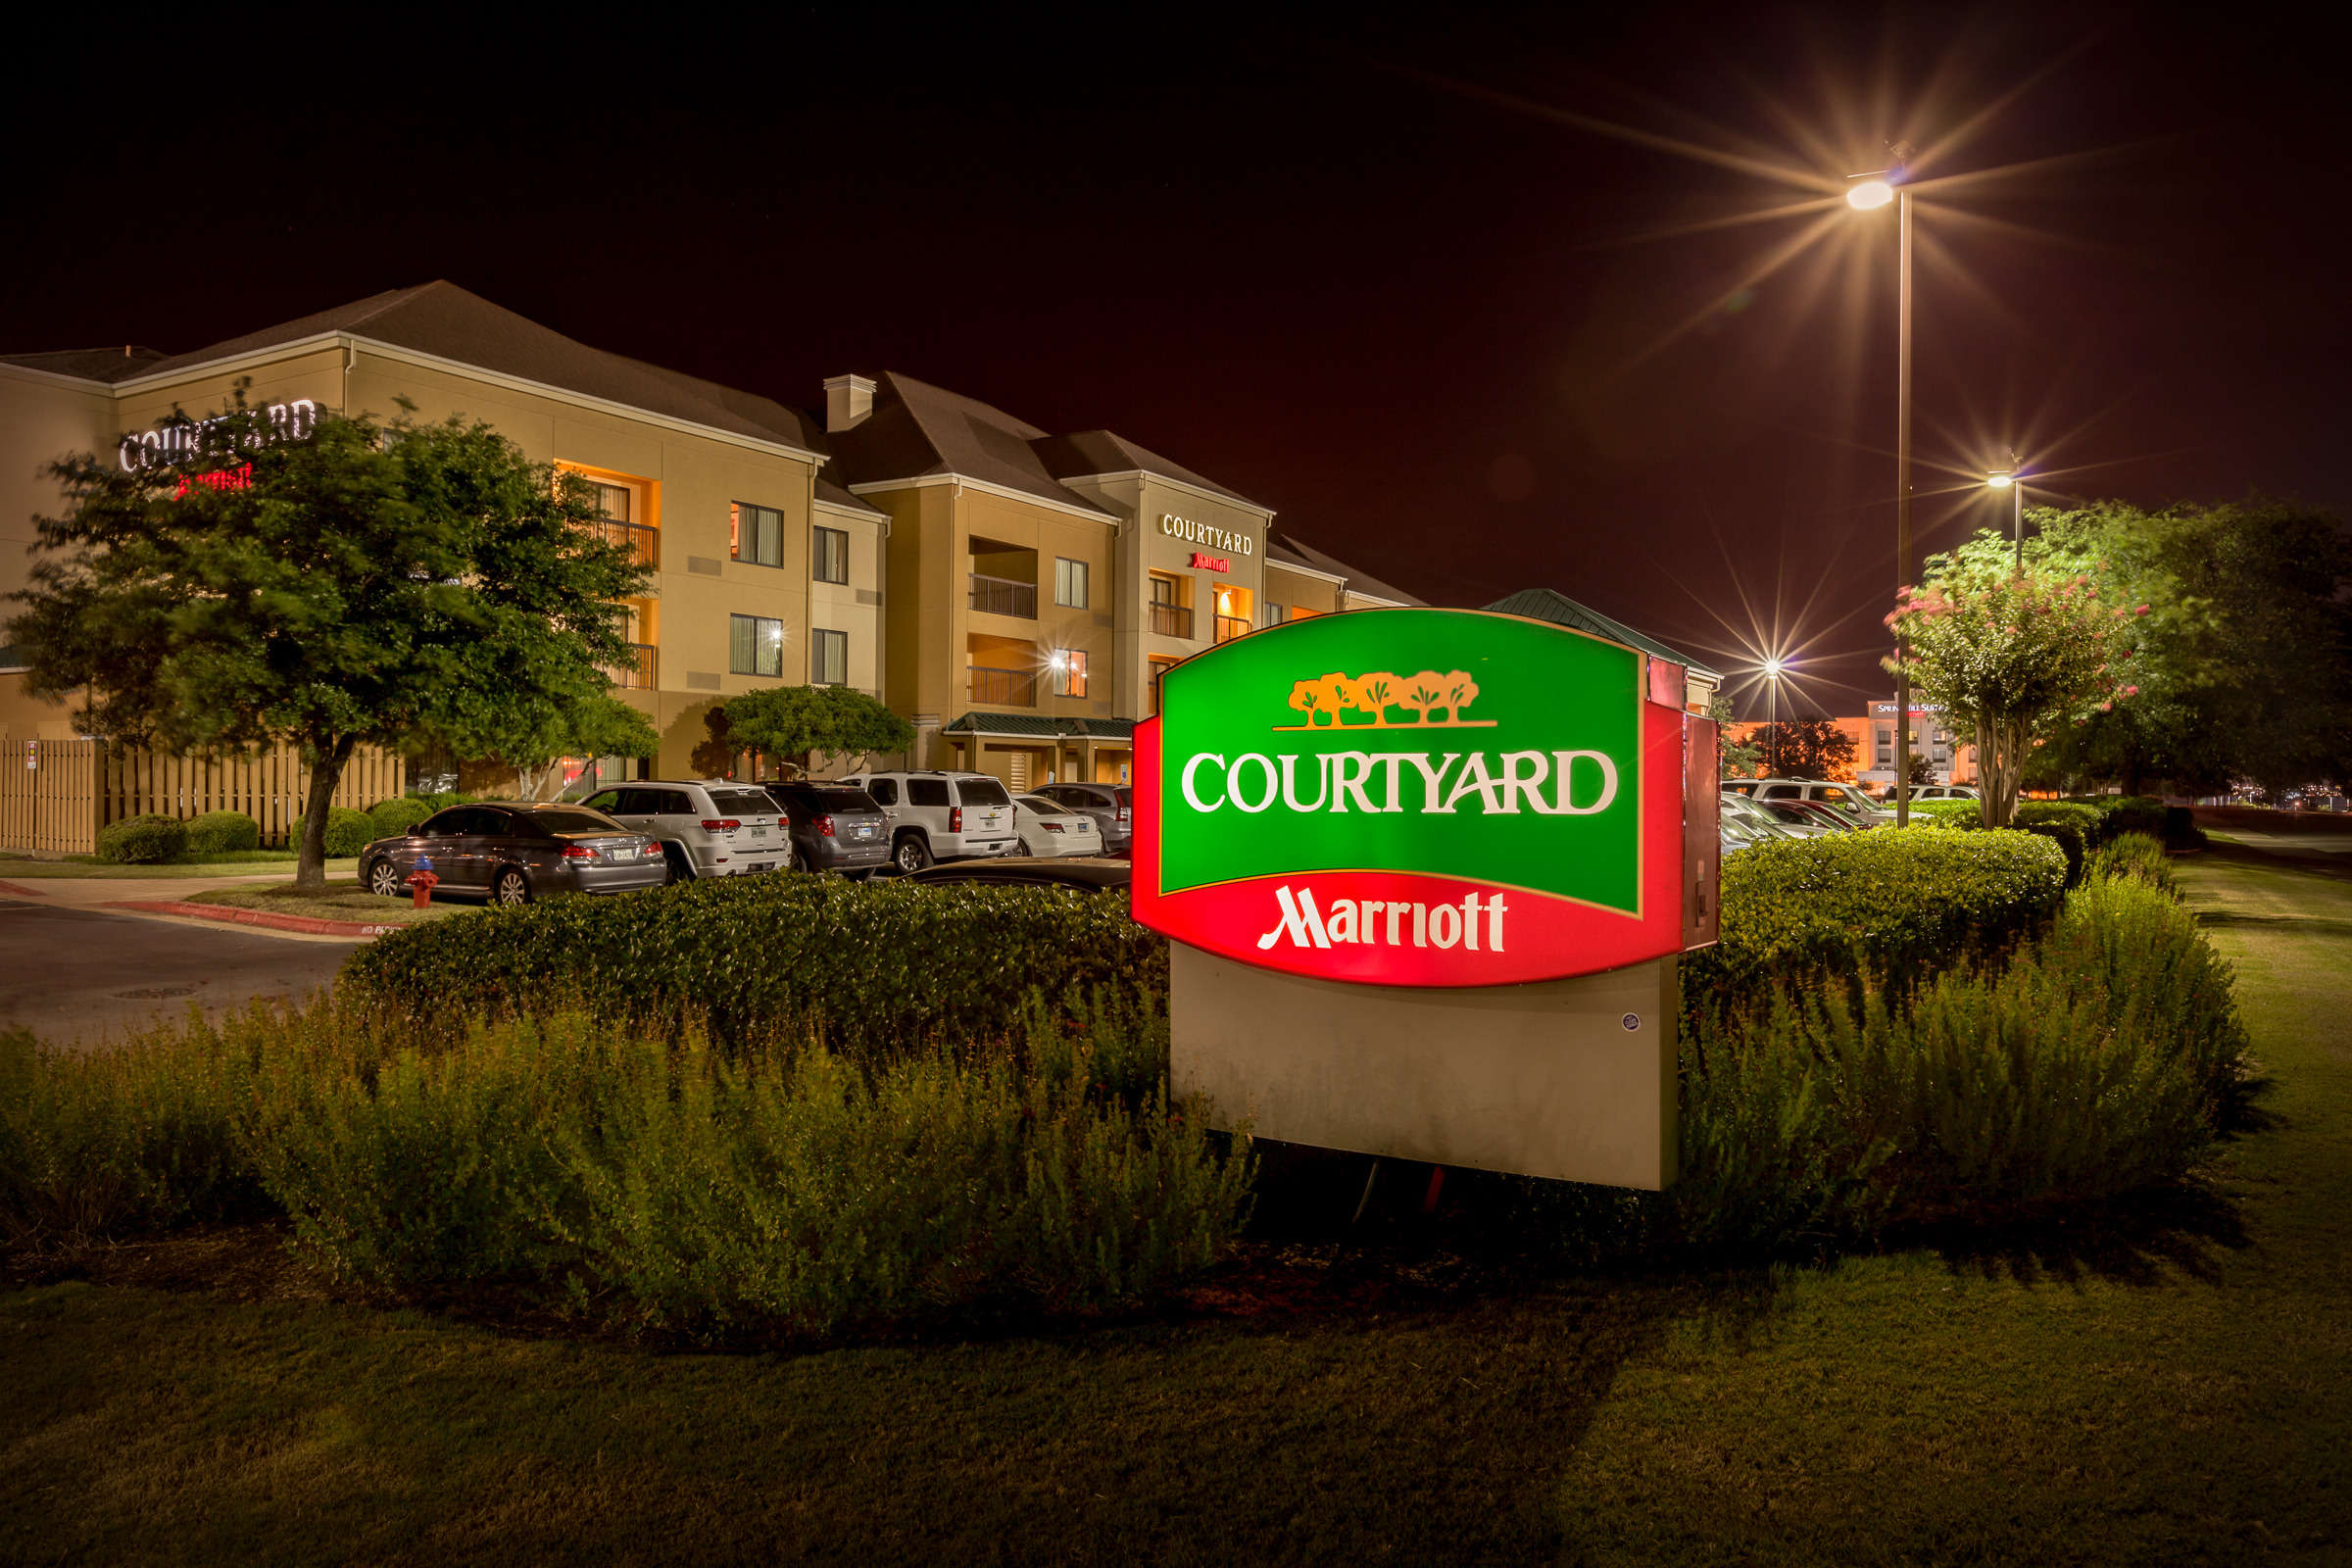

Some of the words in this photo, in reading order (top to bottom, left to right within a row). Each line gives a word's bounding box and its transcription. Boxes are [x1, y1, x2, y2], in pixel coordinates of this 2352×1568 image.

[1162, 514, 1252, 556] COURTYARD
[1194, 552, 1231, 573] Marriott
[1181, 750, 1618, 815] COURTYARD
[1256, 885, 1508, 954] Marriott
